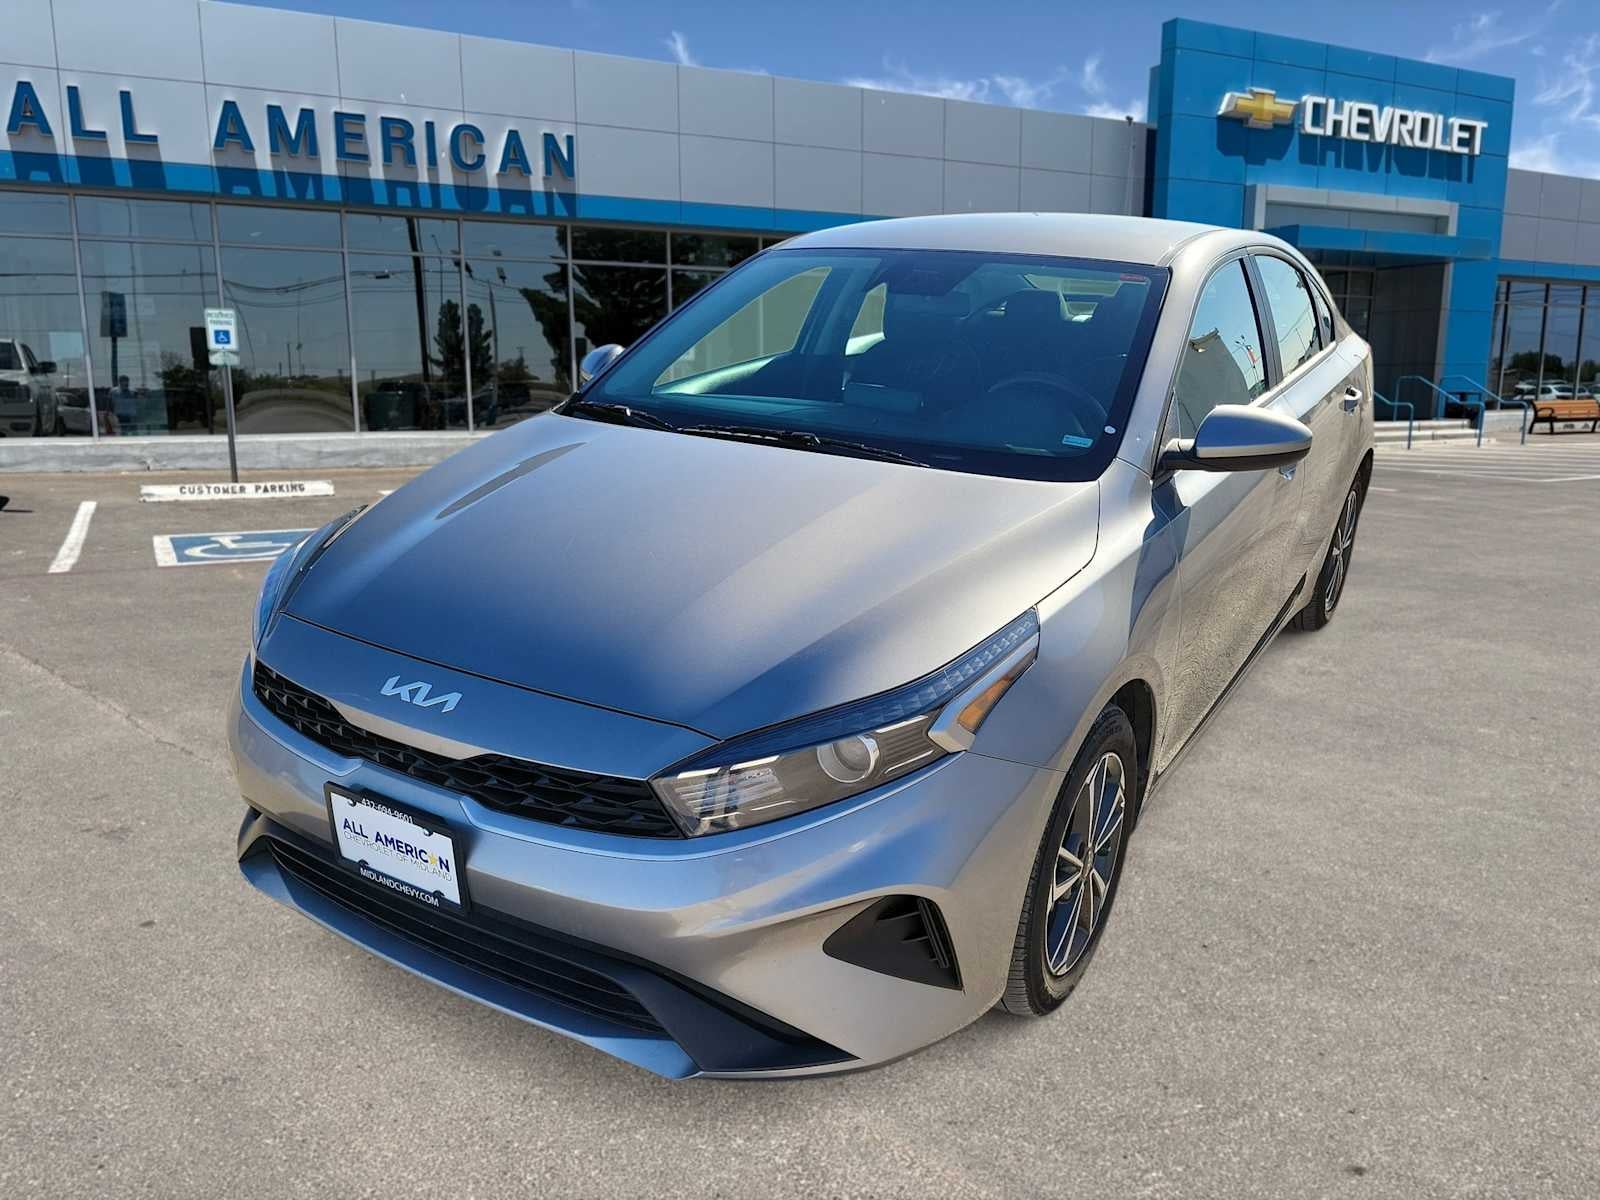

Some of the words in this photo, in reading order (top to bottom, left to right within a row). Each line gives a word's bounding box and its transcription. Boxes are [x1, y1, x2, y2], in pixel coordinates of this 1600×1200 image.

[6, 80, 159, 144] ALL
[212, 99, 576, 180] AMERICAN
[1301, 94, 1488, 155] CHEVROLET
[179, 485, 246, 495] CUSTOMER
[254, 483, 306, 493] PARKING
[343, 818, 368, 839] ALL
[344, 830, 394, 857] CHEVROLET
[360, 867, 440, 908] MIDLANDCHEVY.COM
